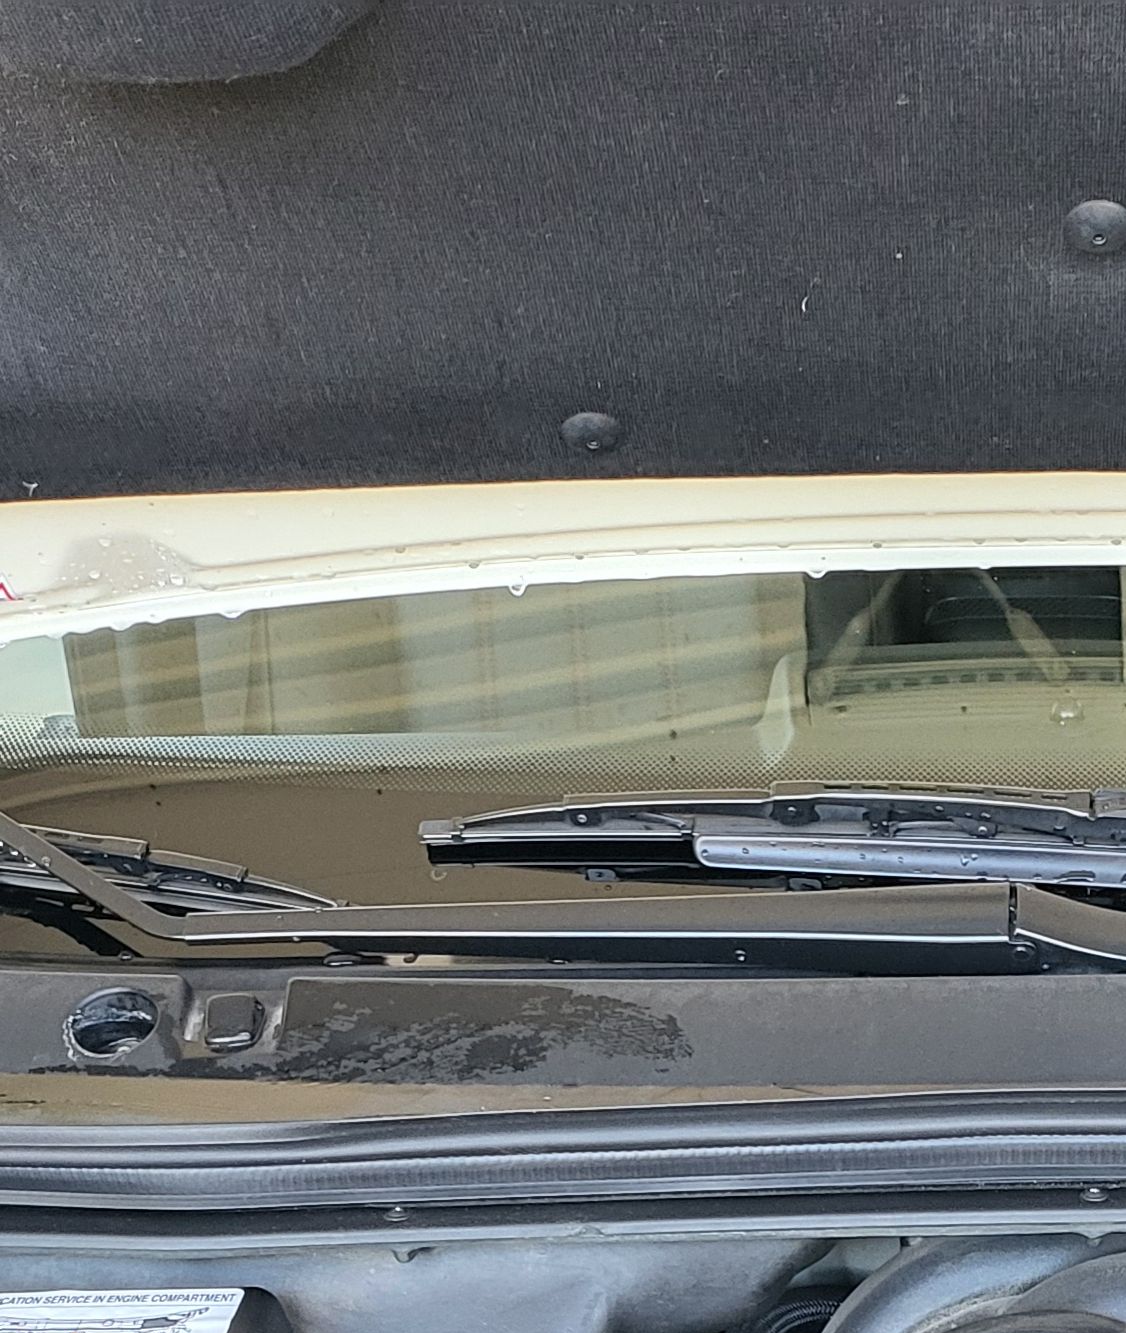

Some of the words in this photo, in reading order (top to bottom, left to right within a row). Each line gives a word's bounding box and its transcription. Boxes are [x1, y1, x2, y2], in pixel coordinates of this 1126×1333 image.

[43, 1295, 92, 1305] SERVICE
[92, 1295, 106, 1303] IN
[106, 1294, 150, 1303] ENGINE
[151, 1293, 237, 1303] COMPARTMENT
